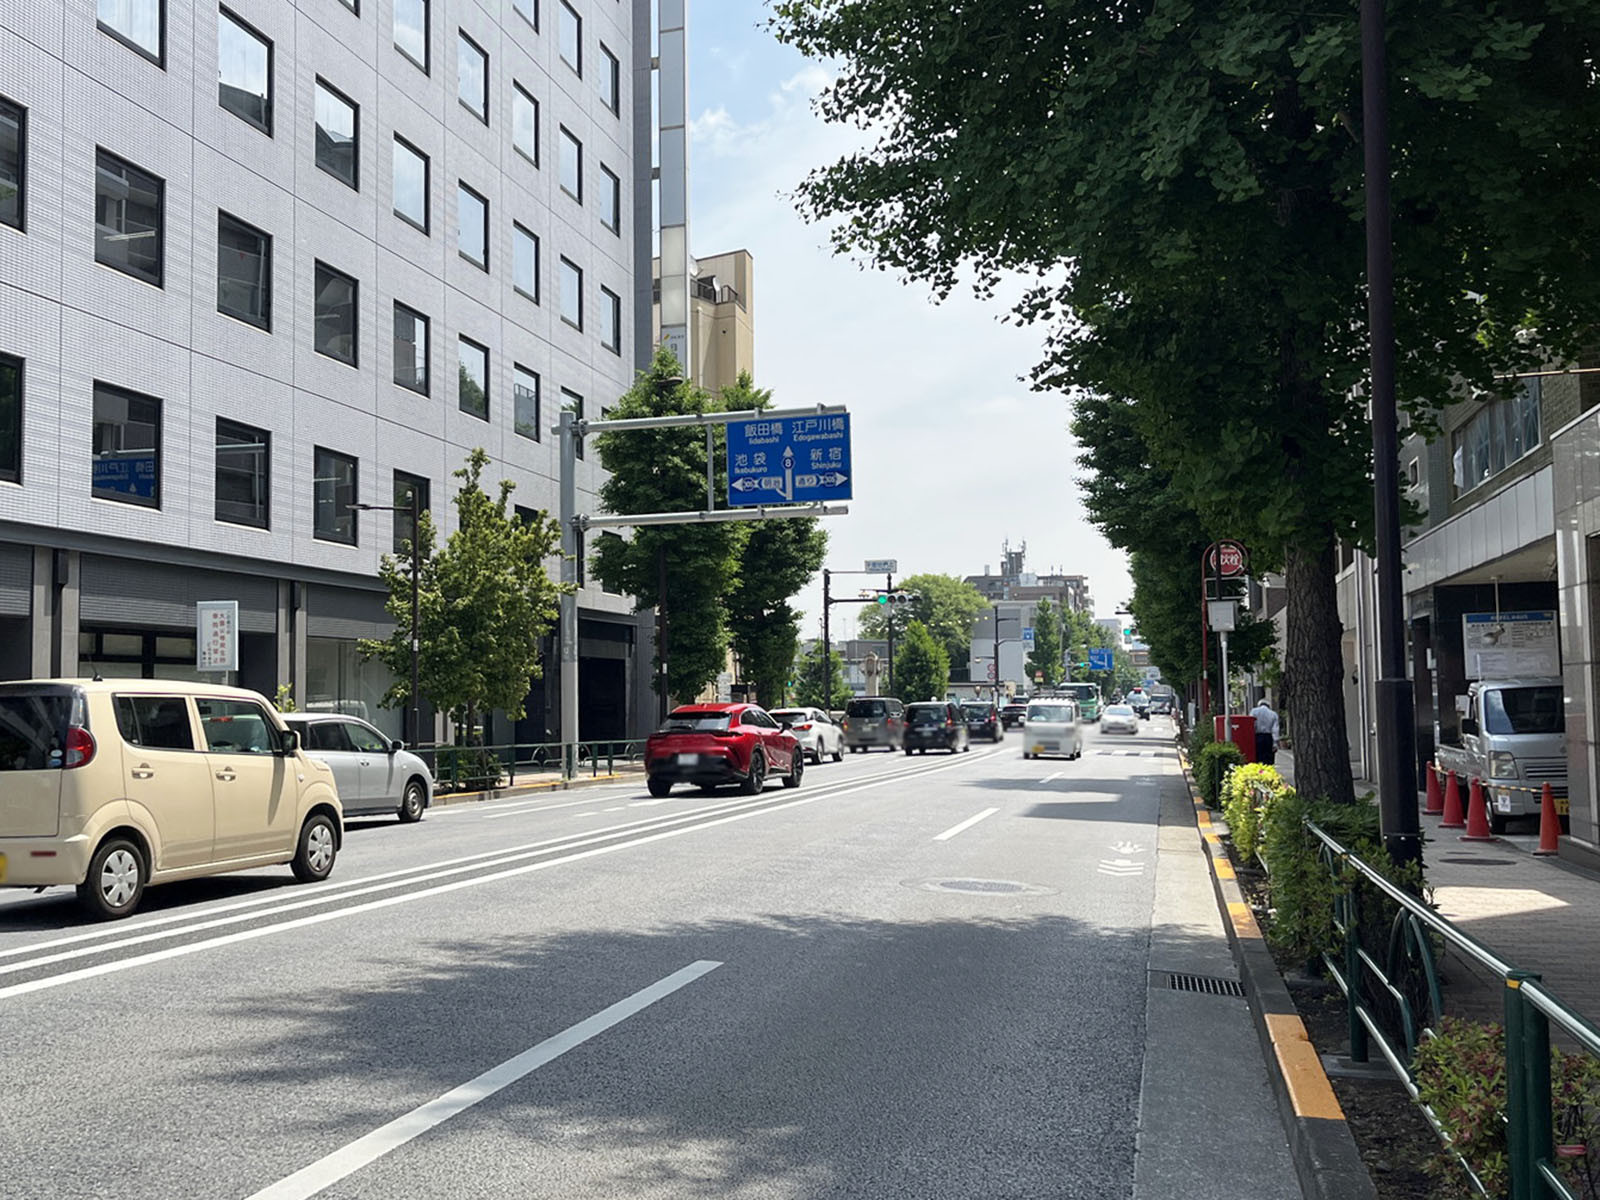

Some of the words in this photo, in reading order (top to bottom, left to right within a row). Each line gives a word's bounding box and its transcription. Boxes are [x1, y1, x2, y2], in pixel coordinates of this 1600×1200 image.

[745, 423, 783, 437] 飯田橋
[792, 418, 844, 433] 江戸川橋
[793, 432, 843, 442] Edogawabashi
[735, 452, 767, 466] 池袋
[810, 447, 842, 461] 新宿
[785, 459, 791, 467] 8
[811, 461, 842, 470] Shinjuku
